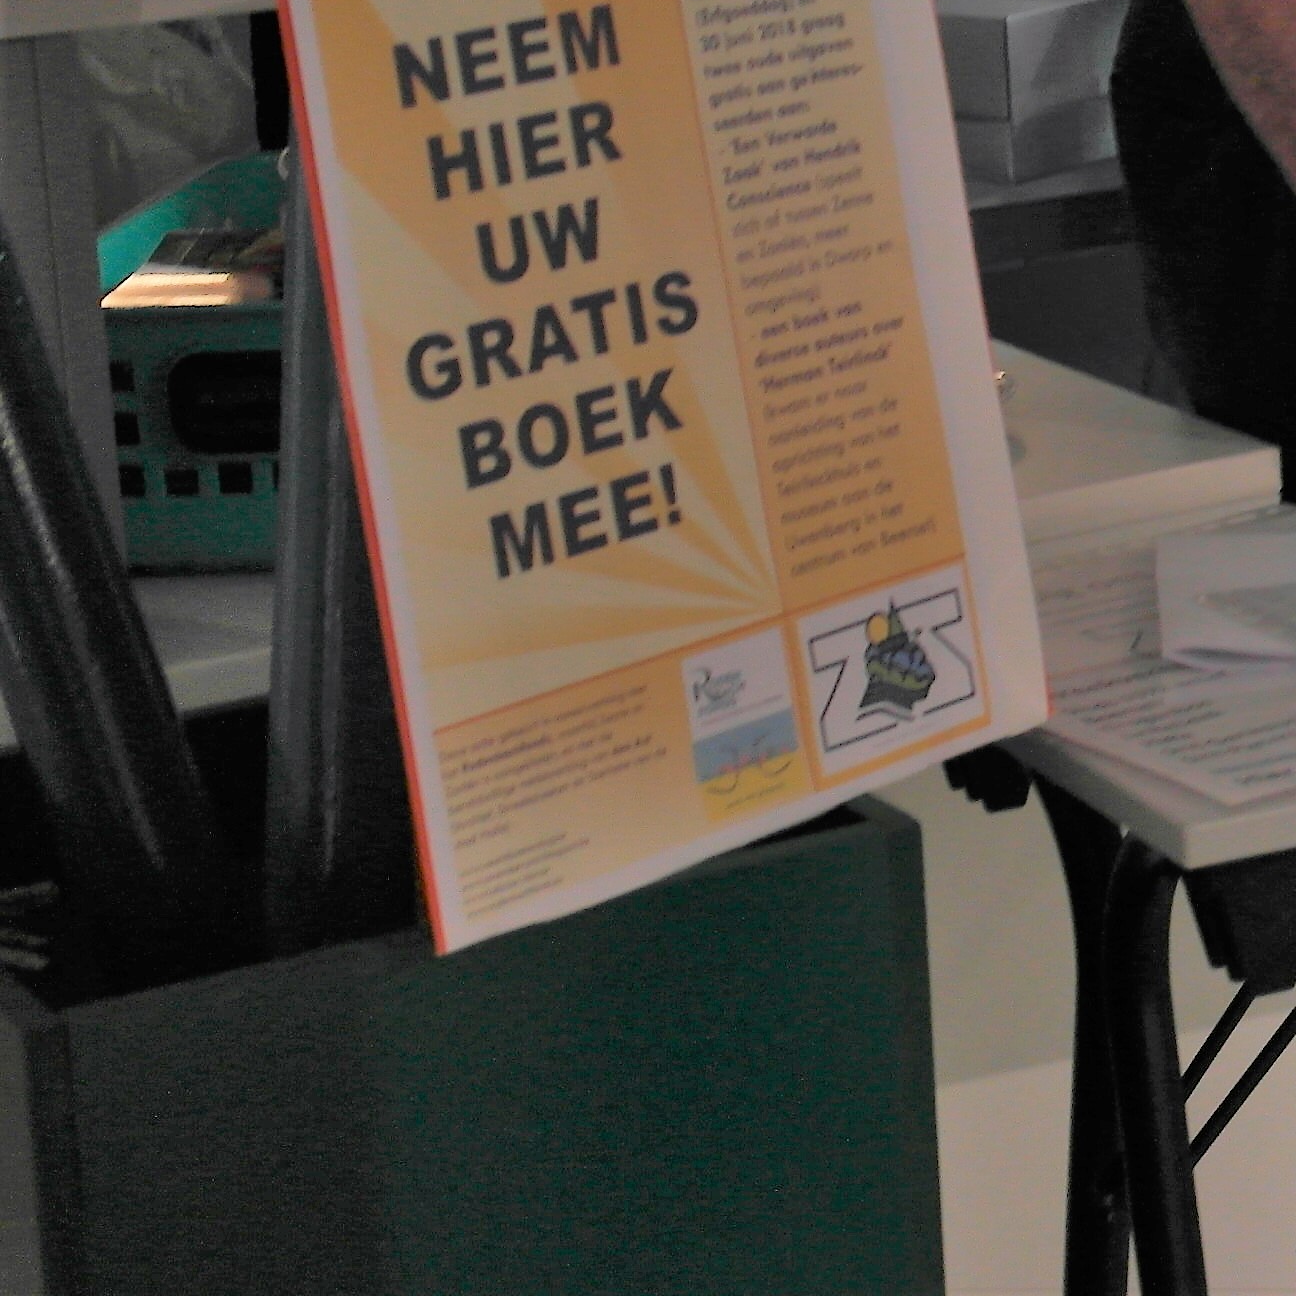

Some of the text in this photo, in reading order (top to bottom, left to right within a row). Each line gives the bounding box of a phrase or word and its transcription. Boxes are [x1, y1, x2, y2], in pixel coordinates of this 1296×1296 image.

[392, 3, 620, 108] NEEM
[703, 37, 853, 77] twee oude uitgaven
[723, 27, 754, 51] juni
[800, 12, 845, 36] graag
[756, 78, 785, 95] aan
[426, 100, 622, 200] HIER
[771, 156, 799, 171] van
[803, 139, 860, 164] Hendrik
[726, 180, 811, 210] Conscience
[476, 197, 598, 283] UW
[406, 271, 698, 400] GRATIS
[458, 367, 683, 488] BOEK
[489, 463, 681, 578] MEE!
